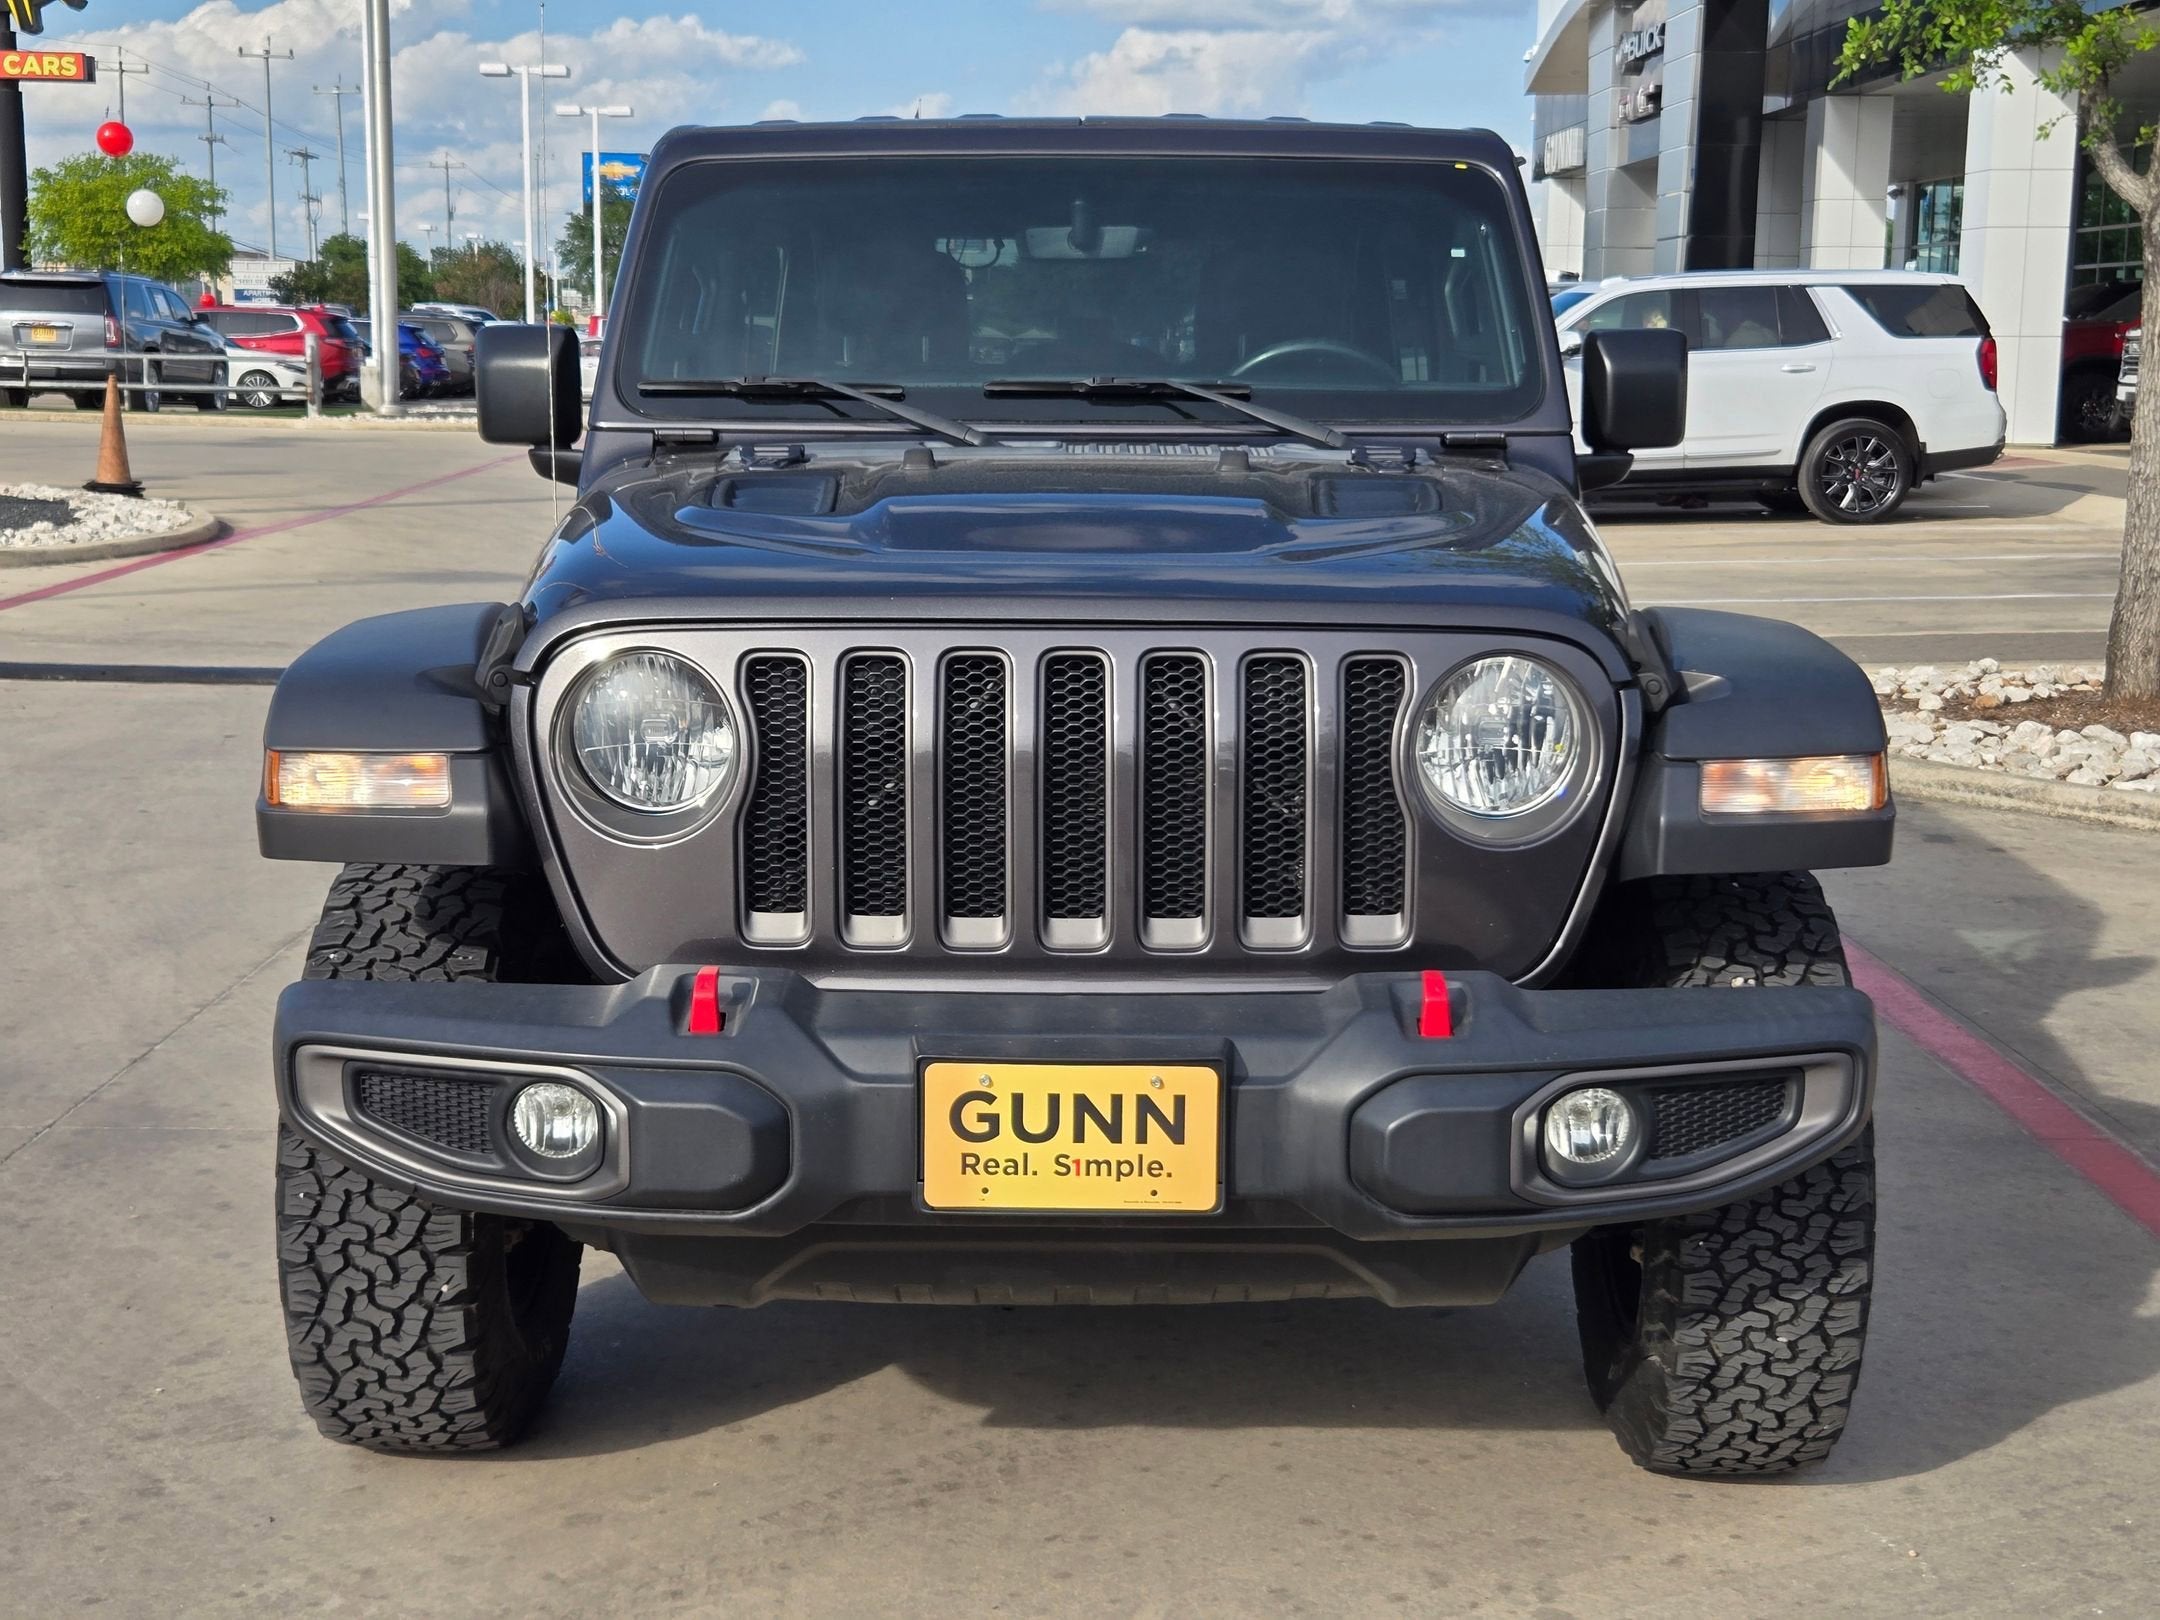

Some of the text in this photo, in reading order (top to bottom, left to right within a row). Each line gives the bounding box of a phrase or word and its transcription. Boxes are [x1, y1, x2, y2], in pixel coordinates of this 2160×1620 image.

[1627, 23, 1665, 61] BUICK
[3, 55, 77, 77] CARS
[949, 1090, 1186, 1145] GUNN
[961, 1152, 1038, 1176] Real.
